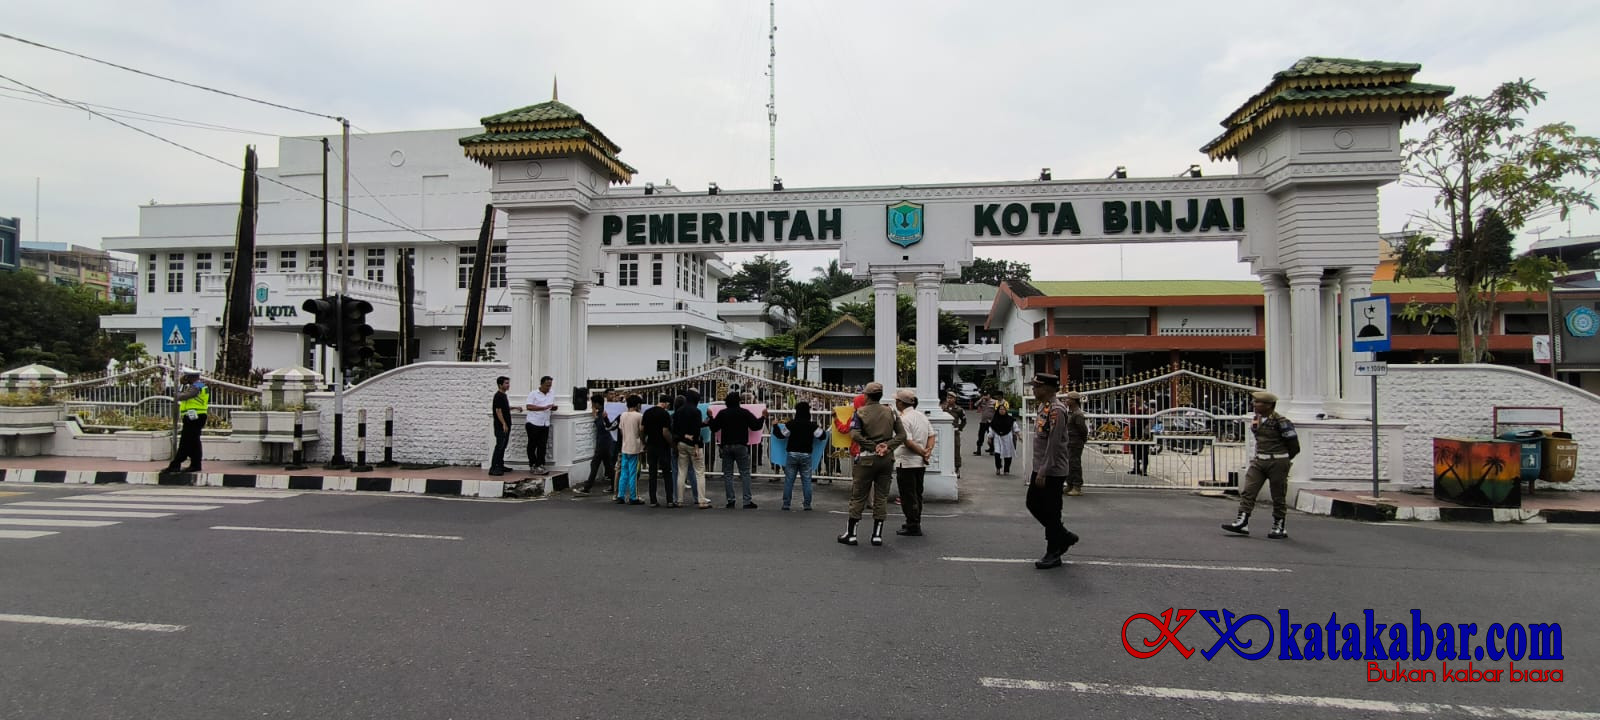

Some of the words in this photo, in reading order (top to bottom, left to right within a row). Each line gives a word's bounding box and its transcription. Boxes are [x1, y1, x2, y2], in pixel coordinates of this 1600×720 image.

[602, 208, 842, 246] PEMERINTAH
[974, 202, 1081, 236] KOTA
[1103, 197, 1245, 235] BINJAI
[266, 305, 297, 317] KOTA
